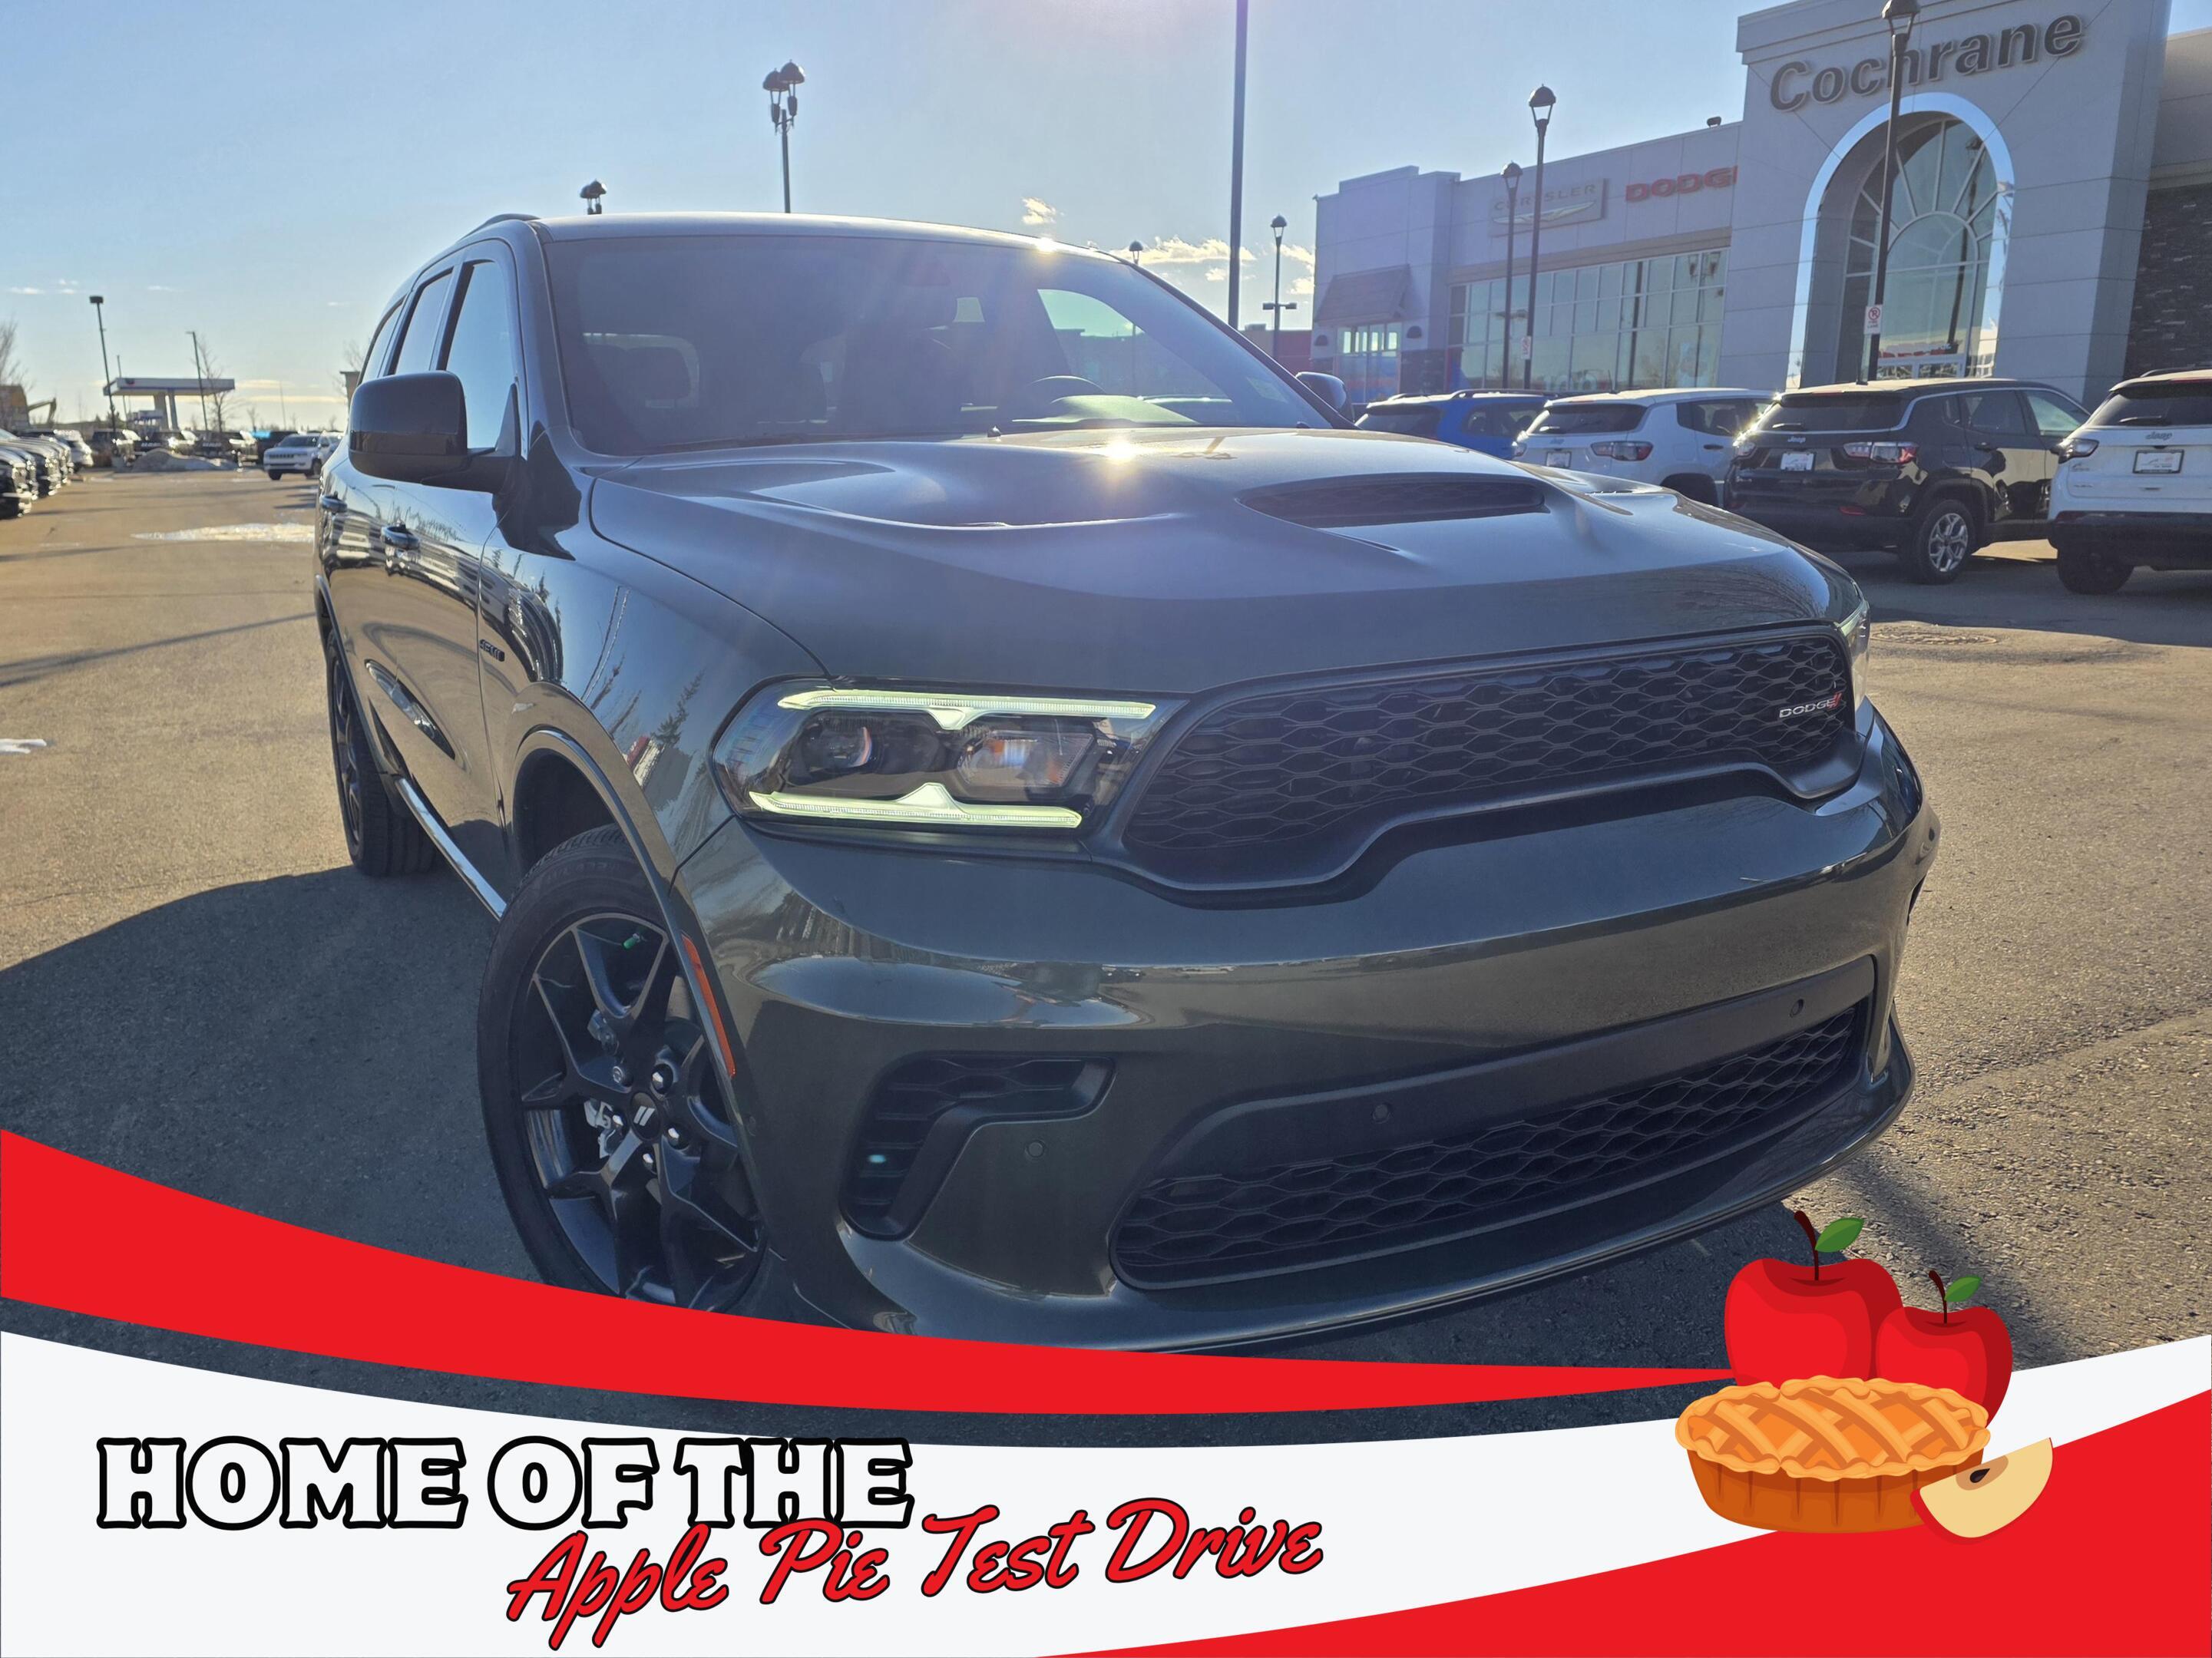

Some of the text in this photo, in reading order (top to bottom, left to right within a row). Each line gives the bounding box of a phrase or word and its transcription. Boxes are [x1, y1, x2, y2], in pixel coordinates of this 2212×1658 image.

[1770, 14, 2087, 112] Cochrane
[1493, 183, 1596, 211] CRSLER
[1625, 165, 1738, 202] DODG
[1779, 698, 1837, 718] DODGE
